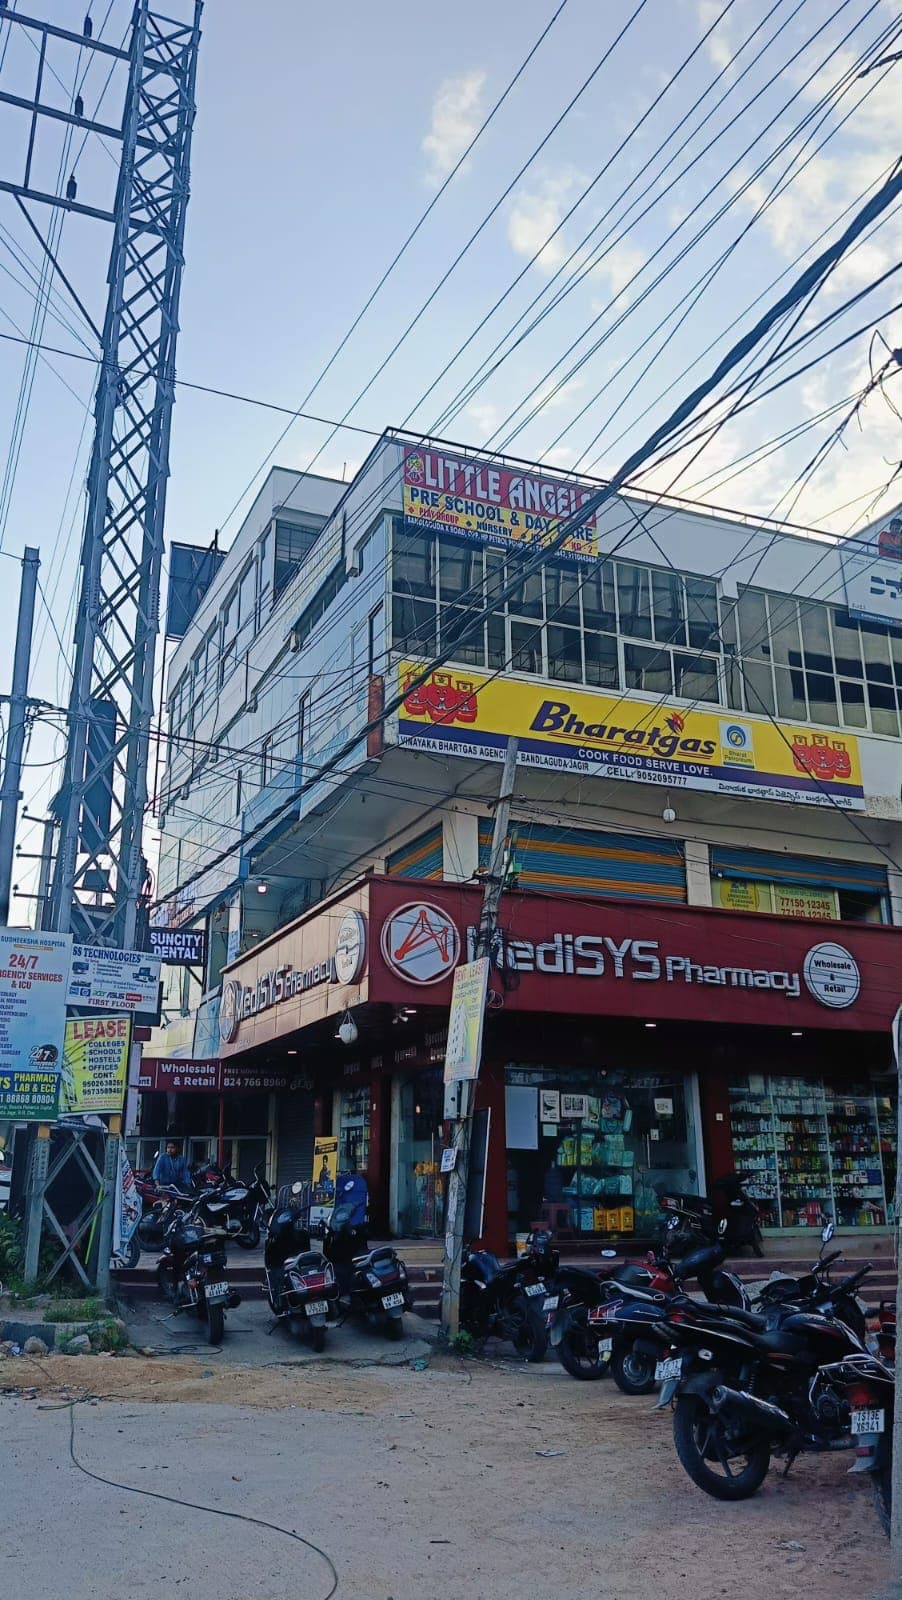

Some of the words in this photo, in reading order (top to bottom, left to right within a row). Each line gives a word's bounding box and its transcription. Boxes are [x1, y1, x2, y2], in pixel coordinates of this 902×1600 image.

[425, 454, 500, 503] LITTLE
[410, 487, 439, 508] PRE
[445, 496, 504, 524] SCHOOL
[510, 511, 520, 526] &
[525, 514, 553, 533] DAY
[476, 520, 513, 537] NURSERY
[588, 545, 593, 554] 2
[529, 700, 717, 758] Bharatgas
[400, 735, 437, 750] VINAYAKA
[439, 741, 478, 755] BHARTGAS
[520, 753, 568, 768] BANDLAGUDA
[569, 761, 589, 771] JAGIR
[636, 768, 687, 786] 9052095777
[578, 749, 609, 761] COOK
[613, 753, 642, 766] FOOD
[646, 759, 680, 771] SERVE
[683, 764, 713, 776] LOVE.
[807, 900, 831, 910] 12345
[150, 932, 201, 947] SUNCITY
[73, 946, 82, 957] SS
[84, 947, 142, 964] TECHNOLOGIES
[153, 945, 199, 960] DENTAL
[9, 953, 39, 970] 24/7
[814, 959, 852, 970] Wholesale
[28, 972, 64, 983] SERVICES
[666, 955, 801, 997] Pharmacy
[11, 980, 17, 989] &
[19, 981, 32, 989] ICU
[235, 964, 286, 1023] MediSYS
[284, 957, 334, 998] Pharmacy
[824, 984, 846, 993] Retail
[107, 991, 125, 1000] ASUS
[88, 998, 110, 1006] FIRST
[112, 999, 137, 1010] FLOOR
[73, 1020, 127, 1040] LEASE
[161, 1063, 216, 1074] Wholesale
[13, 1072, 60, 1083] PHARMACY
[173, 1076, 180, 1086] &
[184, 1076, 216, 1086] Retail
[223, 1078, 241, 1087] 824
[244, 1078, 261, 1087] 766
[14, 1083, 31, 1093] LAB
[32, 1083, 38, 1093] &
[40, 1083, 56, 1093] ECG
[856, 1421, 879, 1432] X6341
